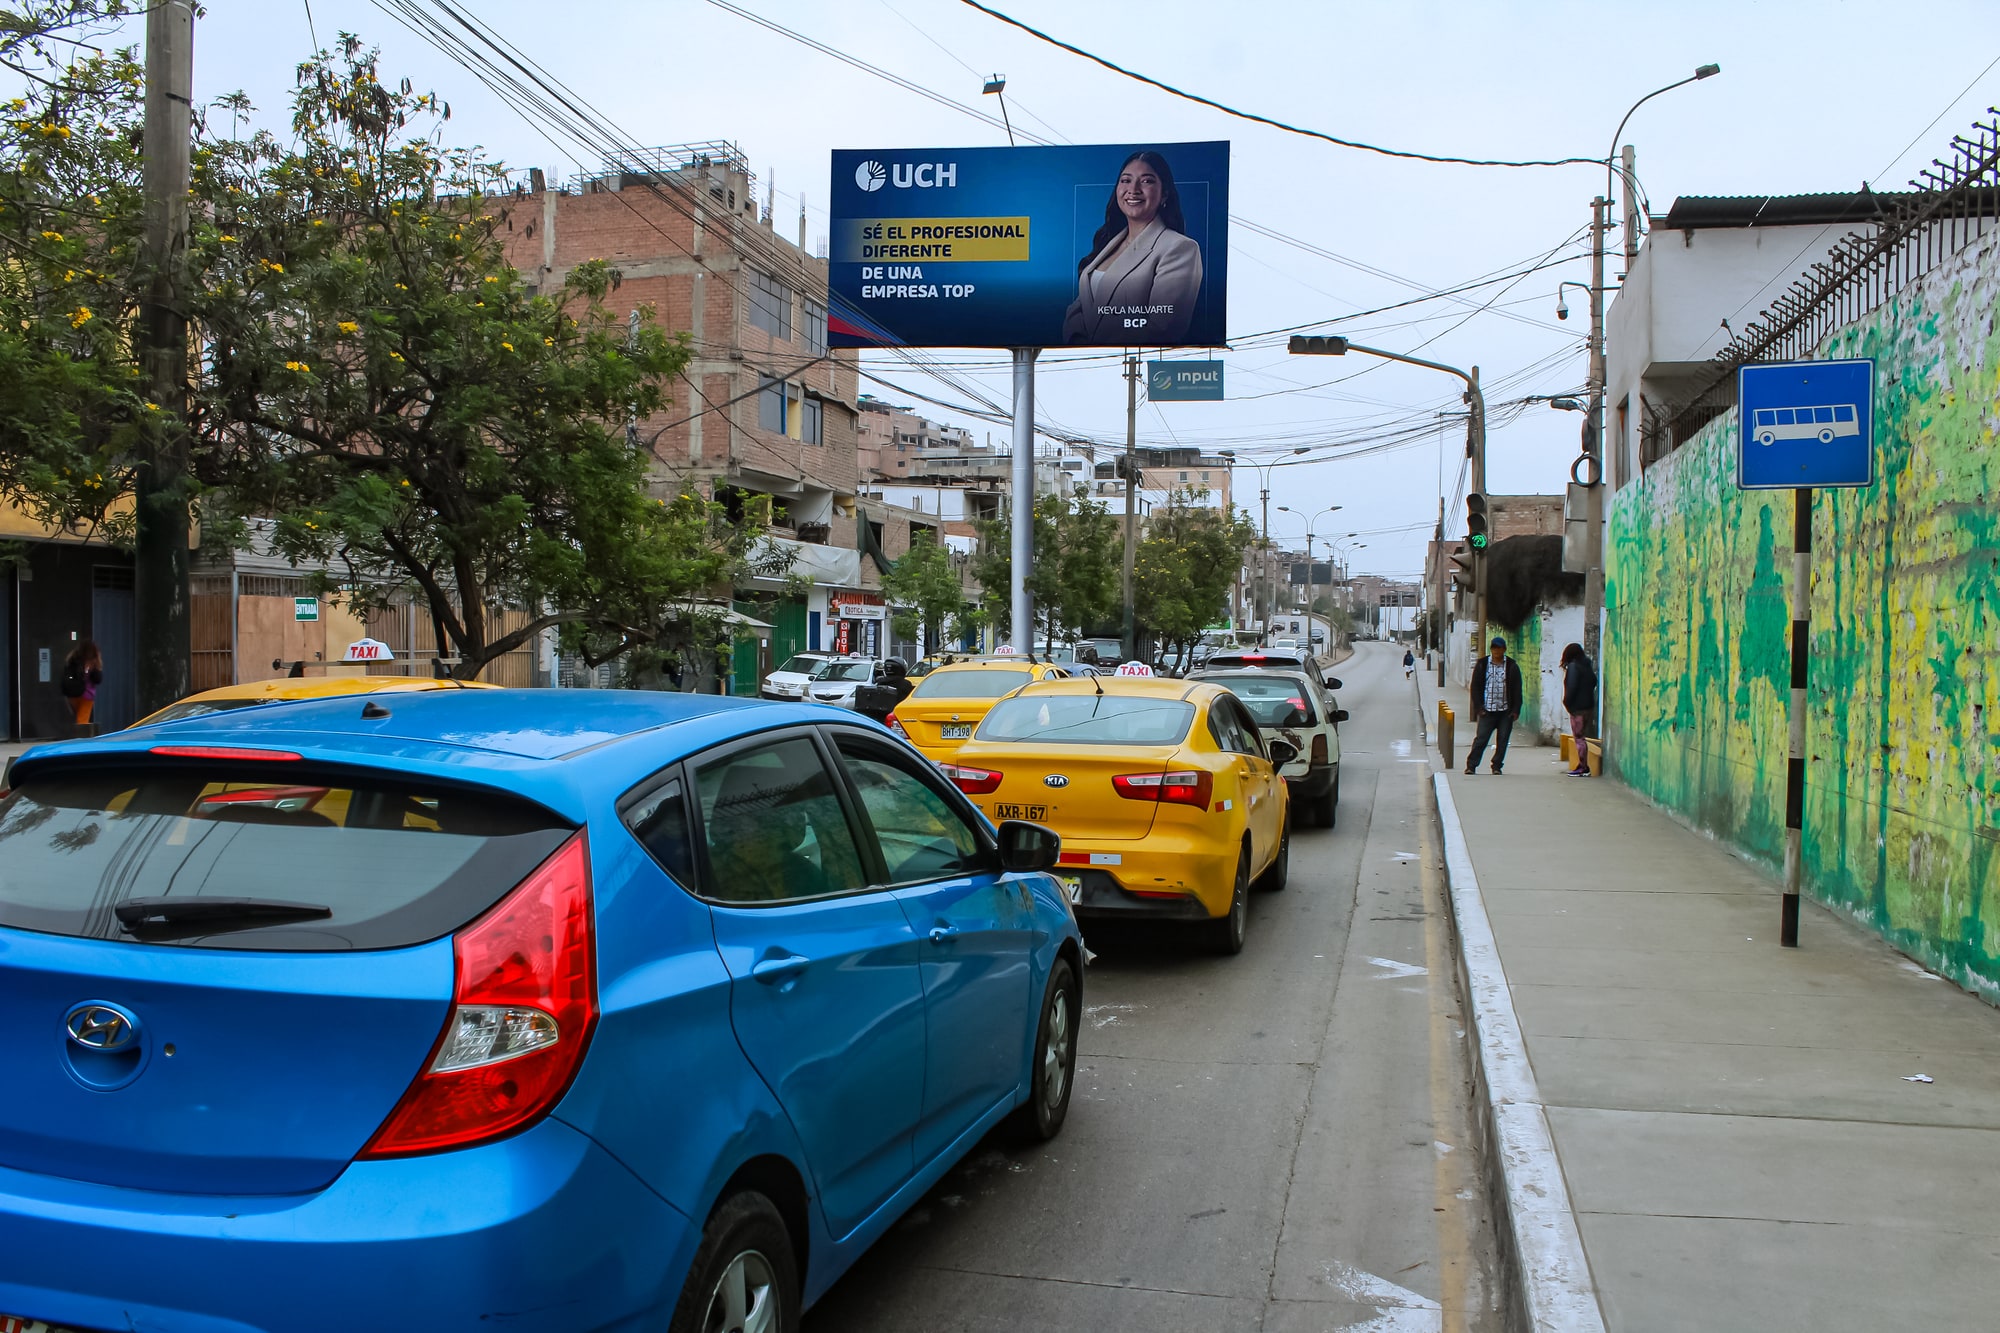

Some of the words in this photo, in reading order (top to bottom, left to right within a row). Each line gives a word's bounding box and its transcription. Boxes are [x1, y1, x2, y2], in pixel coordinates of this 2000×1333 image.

[892, 163, 957, 189] UCH
[863, 223, 883, 240] SÉ
[887, 226, 907, 240] EL
[911, 225, 1025, 239] PROFESIONAL
[862, 244, 952, 258] DIFERENTE
[862, 266, 884, 280] DE
[887, 266, 923, 280] UNA
[861, 285, 939, 299] EMPRESA
[942, 284, 975, 298] TOP
[1097, 305, 1126, 315] KEYLA
[1127, 304, 1174, 315] NALVARTE
[1123, 318, 1148, 328] BCP
[1177, 370, 1219, 385] input
[295, 603, 317, 615] ENTRADA
[351, 646, 379, 659] TAXI
[1120, 665, 1150, 676] TAXI
[942, 727, 970, 737] BHT-198
[1047, 777, 1065, 786] KIA
[997, 804, 1046, 820] AXR-167
